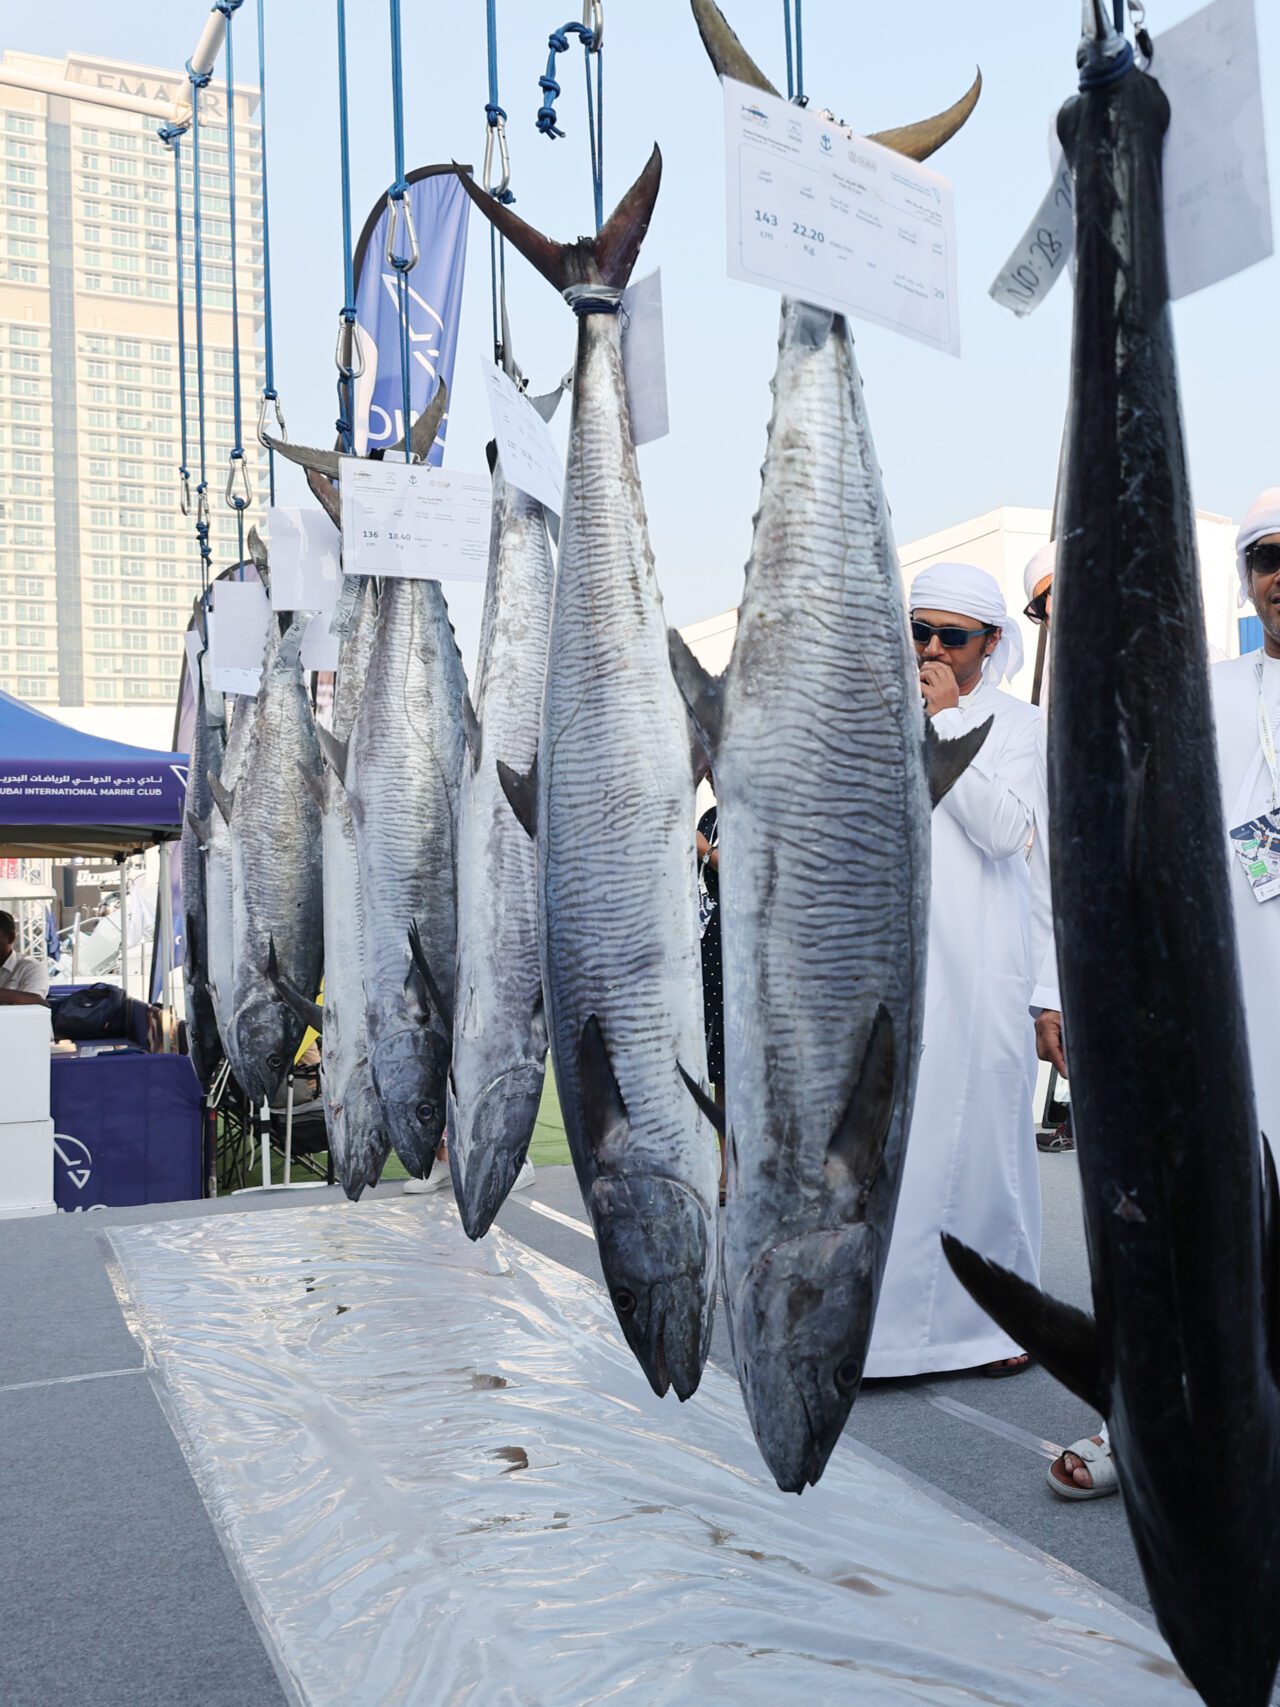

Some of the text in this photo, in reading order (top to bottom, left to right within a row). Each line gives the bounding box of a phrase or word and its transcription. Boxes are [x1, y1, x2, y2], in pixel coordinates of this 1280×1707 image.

[96, 73, 224, 117] EMAR
[754, 209, 825, 244] 143 22.20
[760, 230, 774, 240] cm
[362, 530, 411, 541] 136 18.40
[0, 775, 163, 787] نادي دبي الدولي للرياضات البحري
[0, 788, 162, 796] UBAI INTERNATIONAL MARINE CLUB
